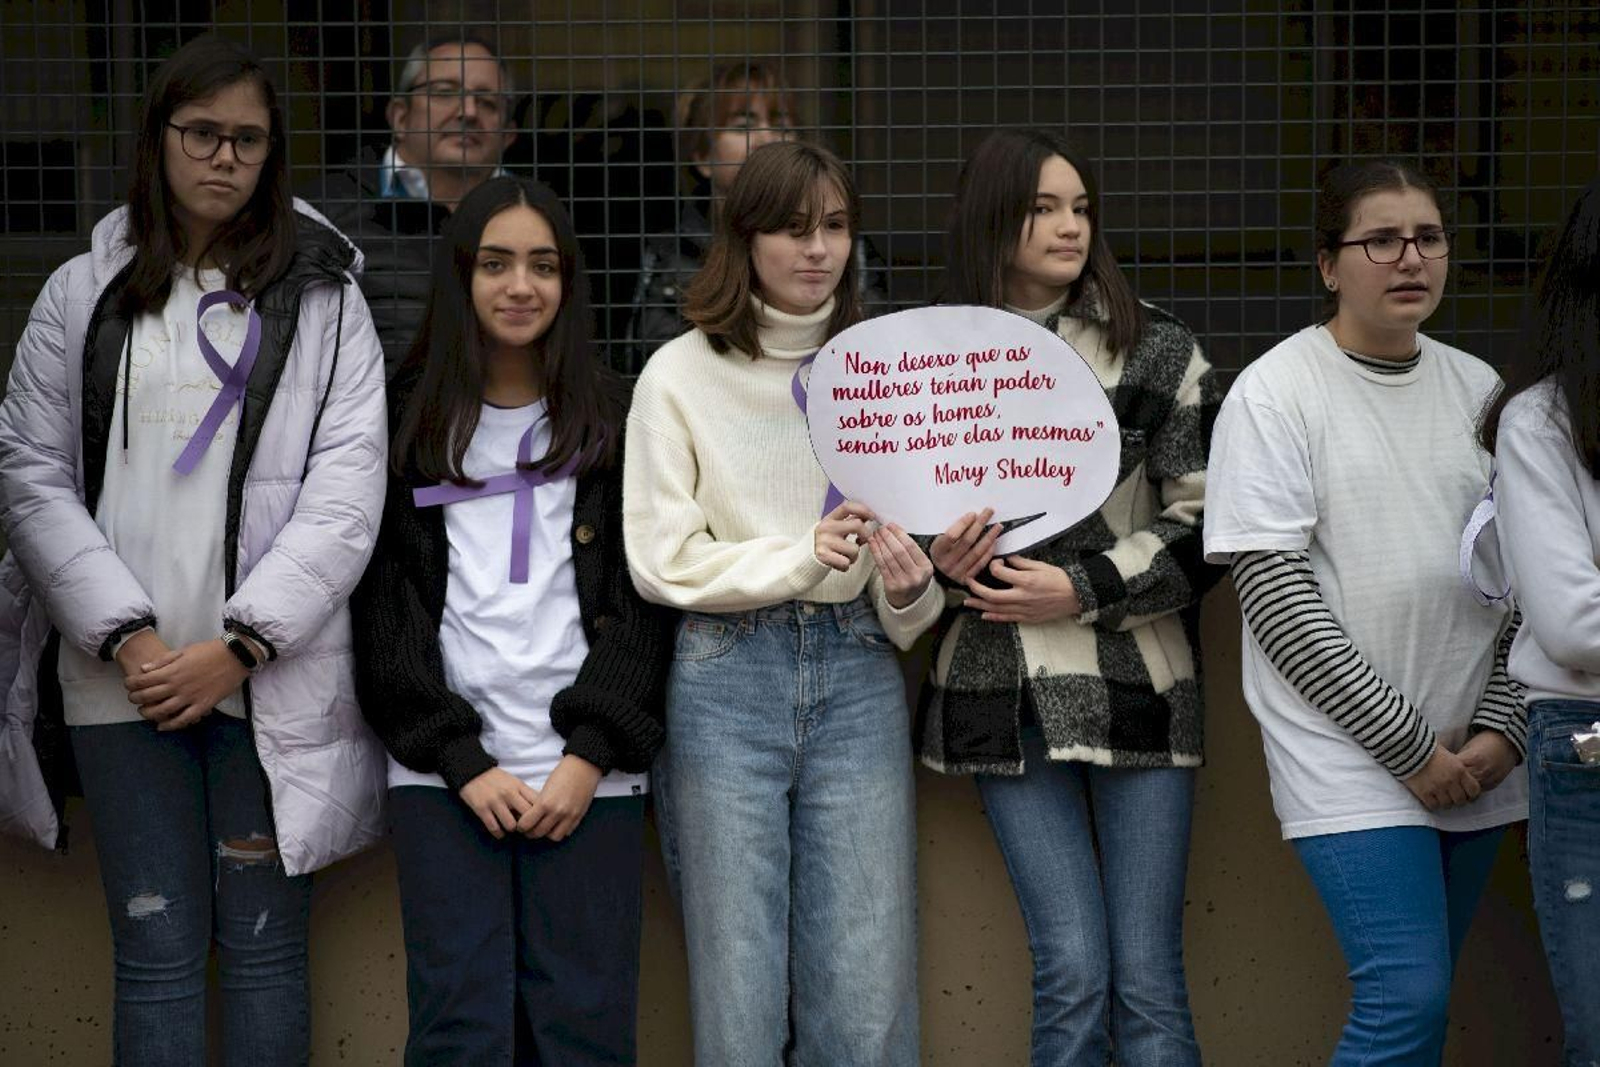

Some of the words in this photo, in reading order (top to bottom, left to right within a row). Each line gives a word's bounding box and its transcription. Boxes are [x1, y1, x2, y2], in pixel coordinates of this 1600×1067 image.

[897, 351, 960, 373] desexo
[965, 348, 1000, 373] que
[1006, 346, 1031, 362] as
[832, 379, 923, 401] mulleres
[993, 370, 1056, 399] poder
[837, 408, 898, 430] sobre
[903, 411, 926, 426] os
[835, 432, 899, 454] senón
[904, 429, 958, 452] sobre
[963, 423, 1004, 445] elas
[935, 462, 989, 488] Mary
[996, 457, 1076, 487] Shelley
